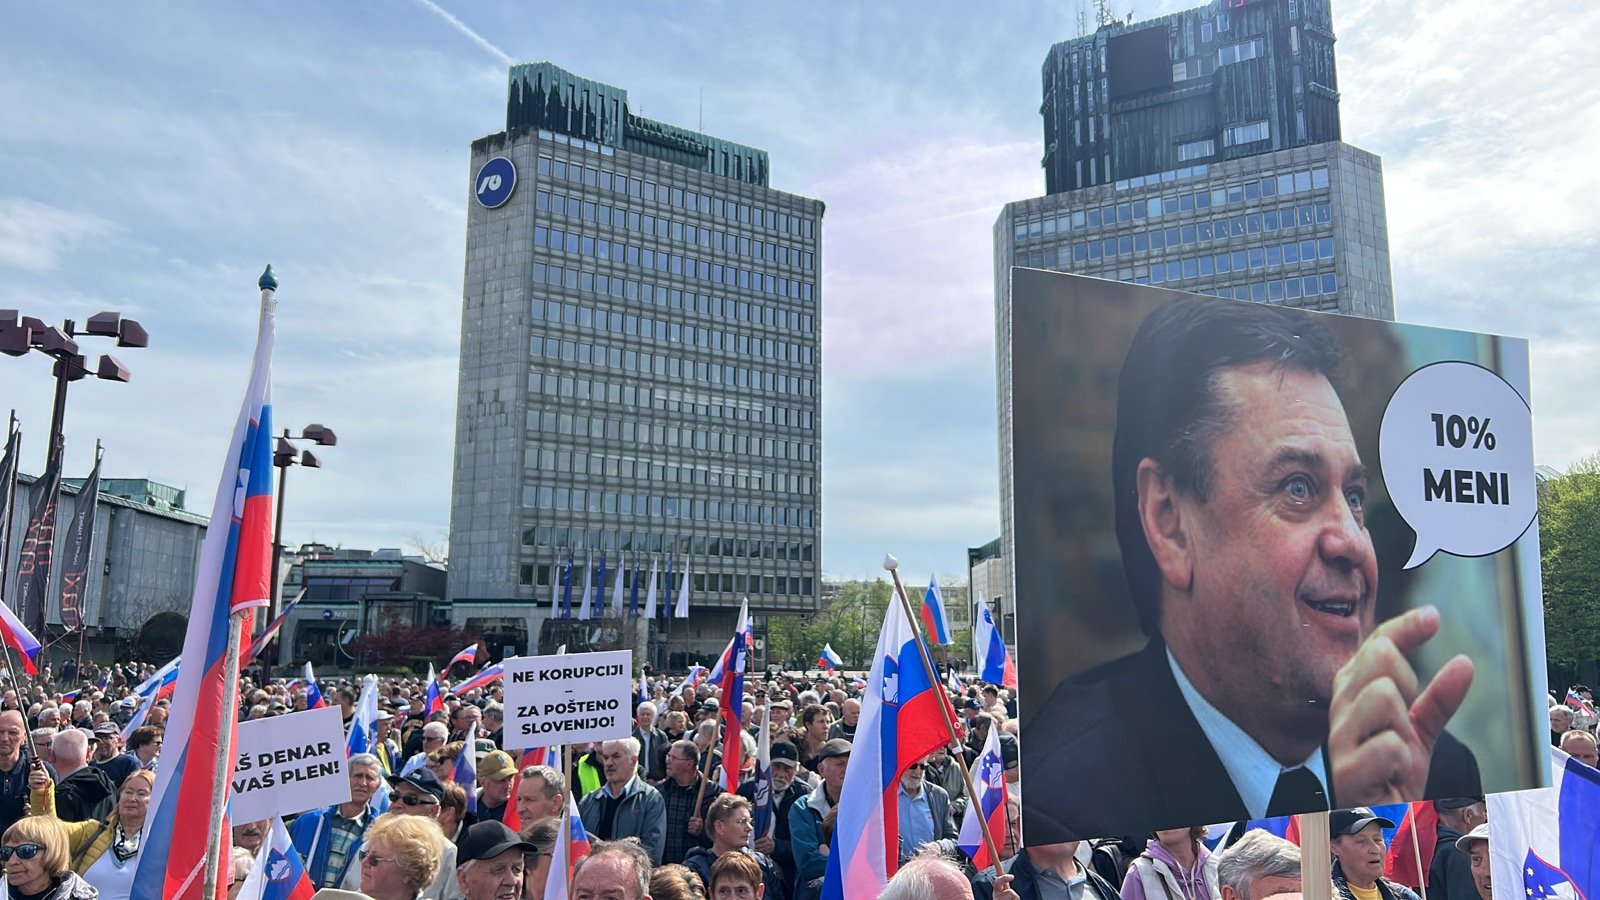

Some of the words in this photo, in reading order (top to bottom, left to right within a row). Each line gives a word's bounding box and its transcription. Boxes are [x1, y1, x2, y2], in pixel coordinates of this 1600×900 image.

[1431, 413, 1496, 450] 10%
[1423, 468, 1510, 505] MENI
[513, 671, 534, 683] NE
[539, 664, 623, 681] KORUPCIJI
[517, 706, 539, 718] ZA
[544, 699, 619, 716] POŠTENO
[521, 716, 615, 735] SLOVENIJO!
[258, 742, 331, 767] DENAR
[232, 770, 275, 794] VAŠ
[281, 761, 340, 785] PLEN!
